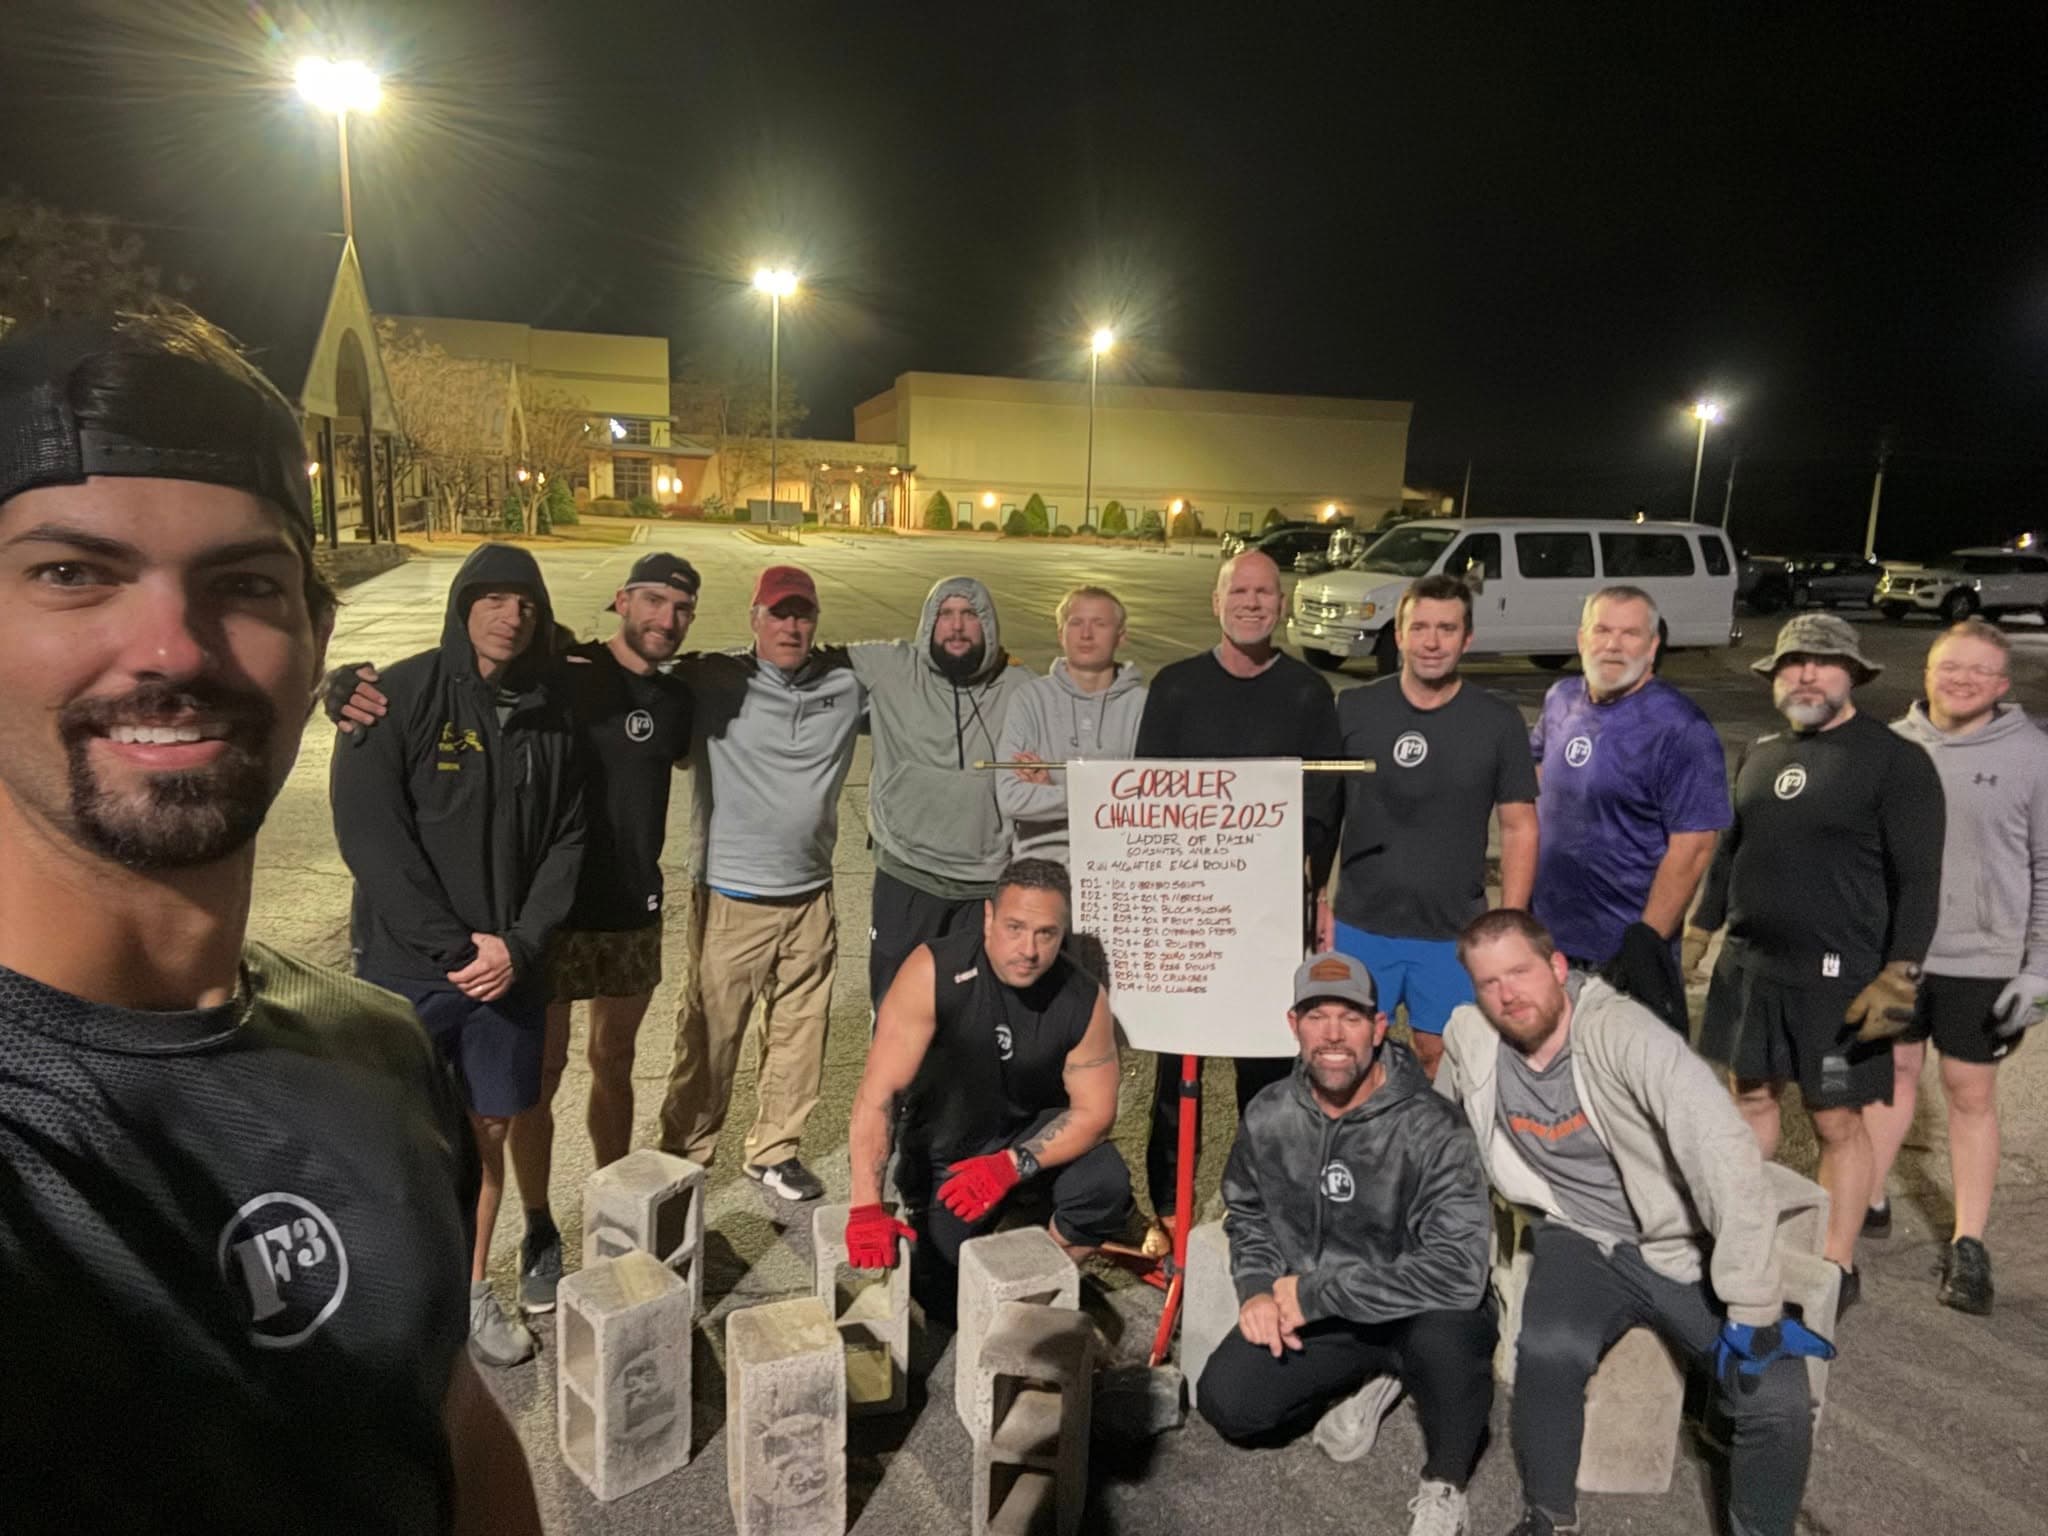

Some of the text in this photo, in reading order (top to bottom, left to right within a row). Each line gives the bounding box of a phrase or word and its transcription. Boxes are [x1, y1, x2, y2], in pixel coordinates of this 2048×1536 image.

[1111, 768, 1237, 800] GOBBLER
[1095, 802, 1288, 830] CHALLENGE 2025
[1187, 834, 1207, 847] OF
[1169, 860, 1199, 871] EACH
[1203, 859, 1247, 872] ROUND
[232, 1217, 327, 1321] F3
